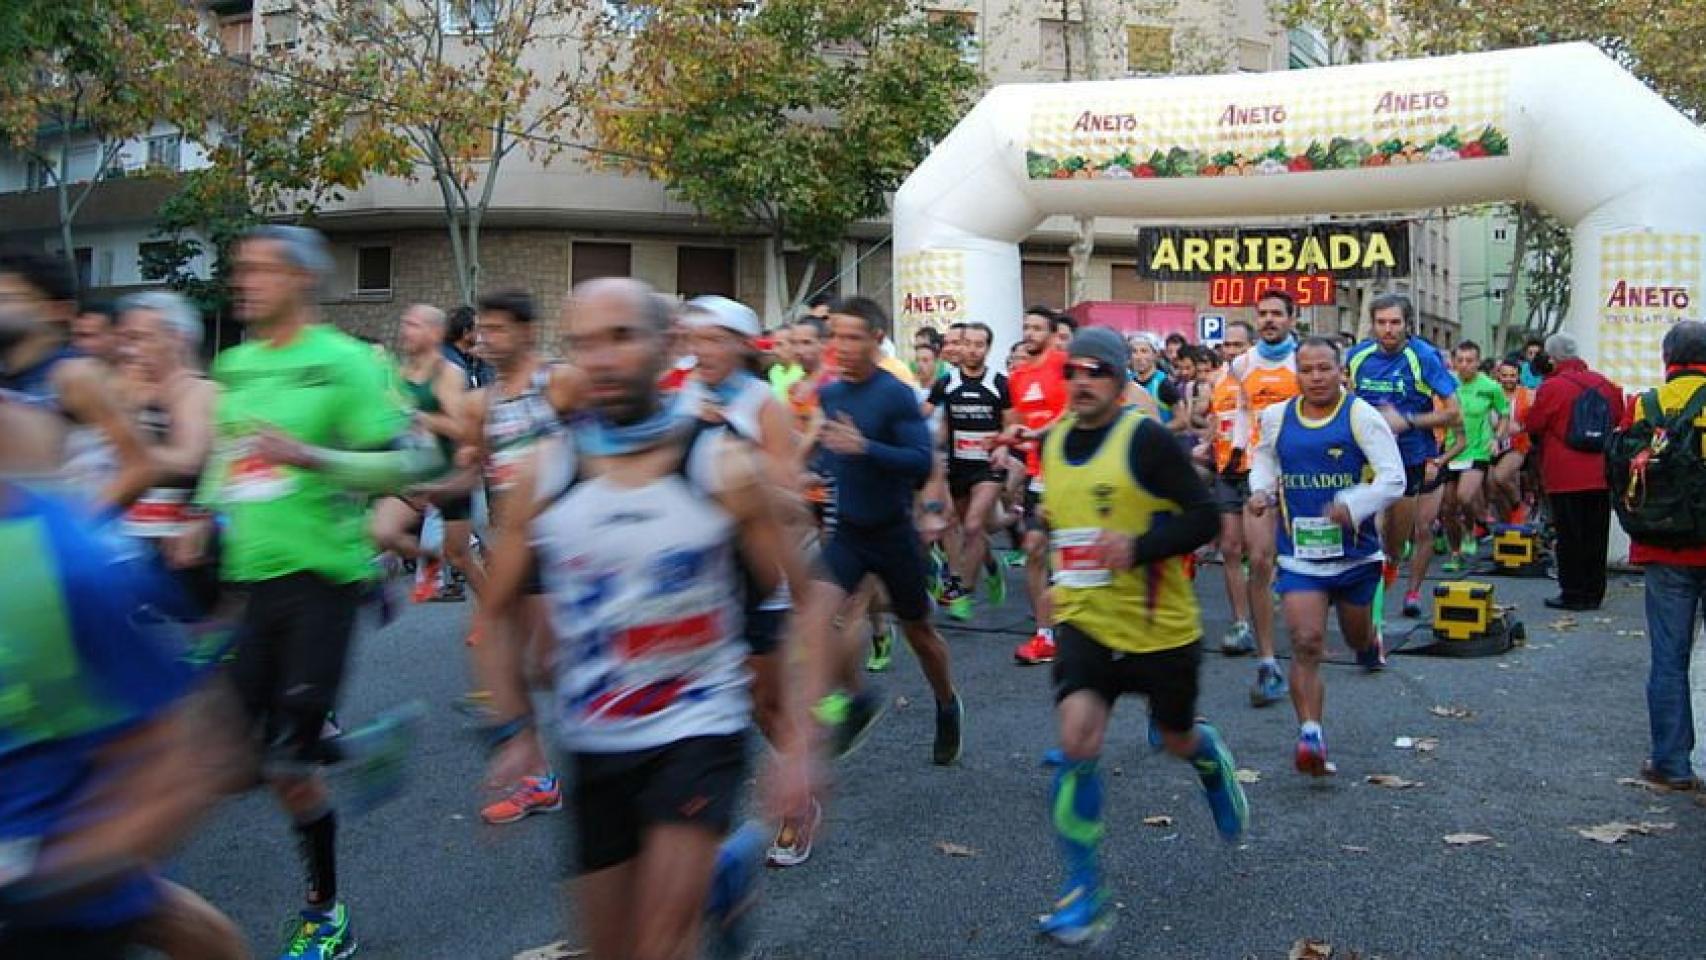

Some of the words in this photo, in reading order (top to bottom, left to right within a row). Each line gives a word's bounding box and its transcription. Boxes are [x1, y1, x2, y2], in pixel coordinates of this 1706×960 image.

[1373, 91, 1449, 114] ANETO
[1073, 110, 1137, 132] ANETO
[1218, 104, 1286, 127] ANETO
[1151, 232, 1396, 272] ARRIBADA
[1212, 278, 1244, 304] 00
[1297, 276, 1329, 304] 57
[1607, 279, 1689, 309] ANETO
[1205, 318, 1220, 340] P
